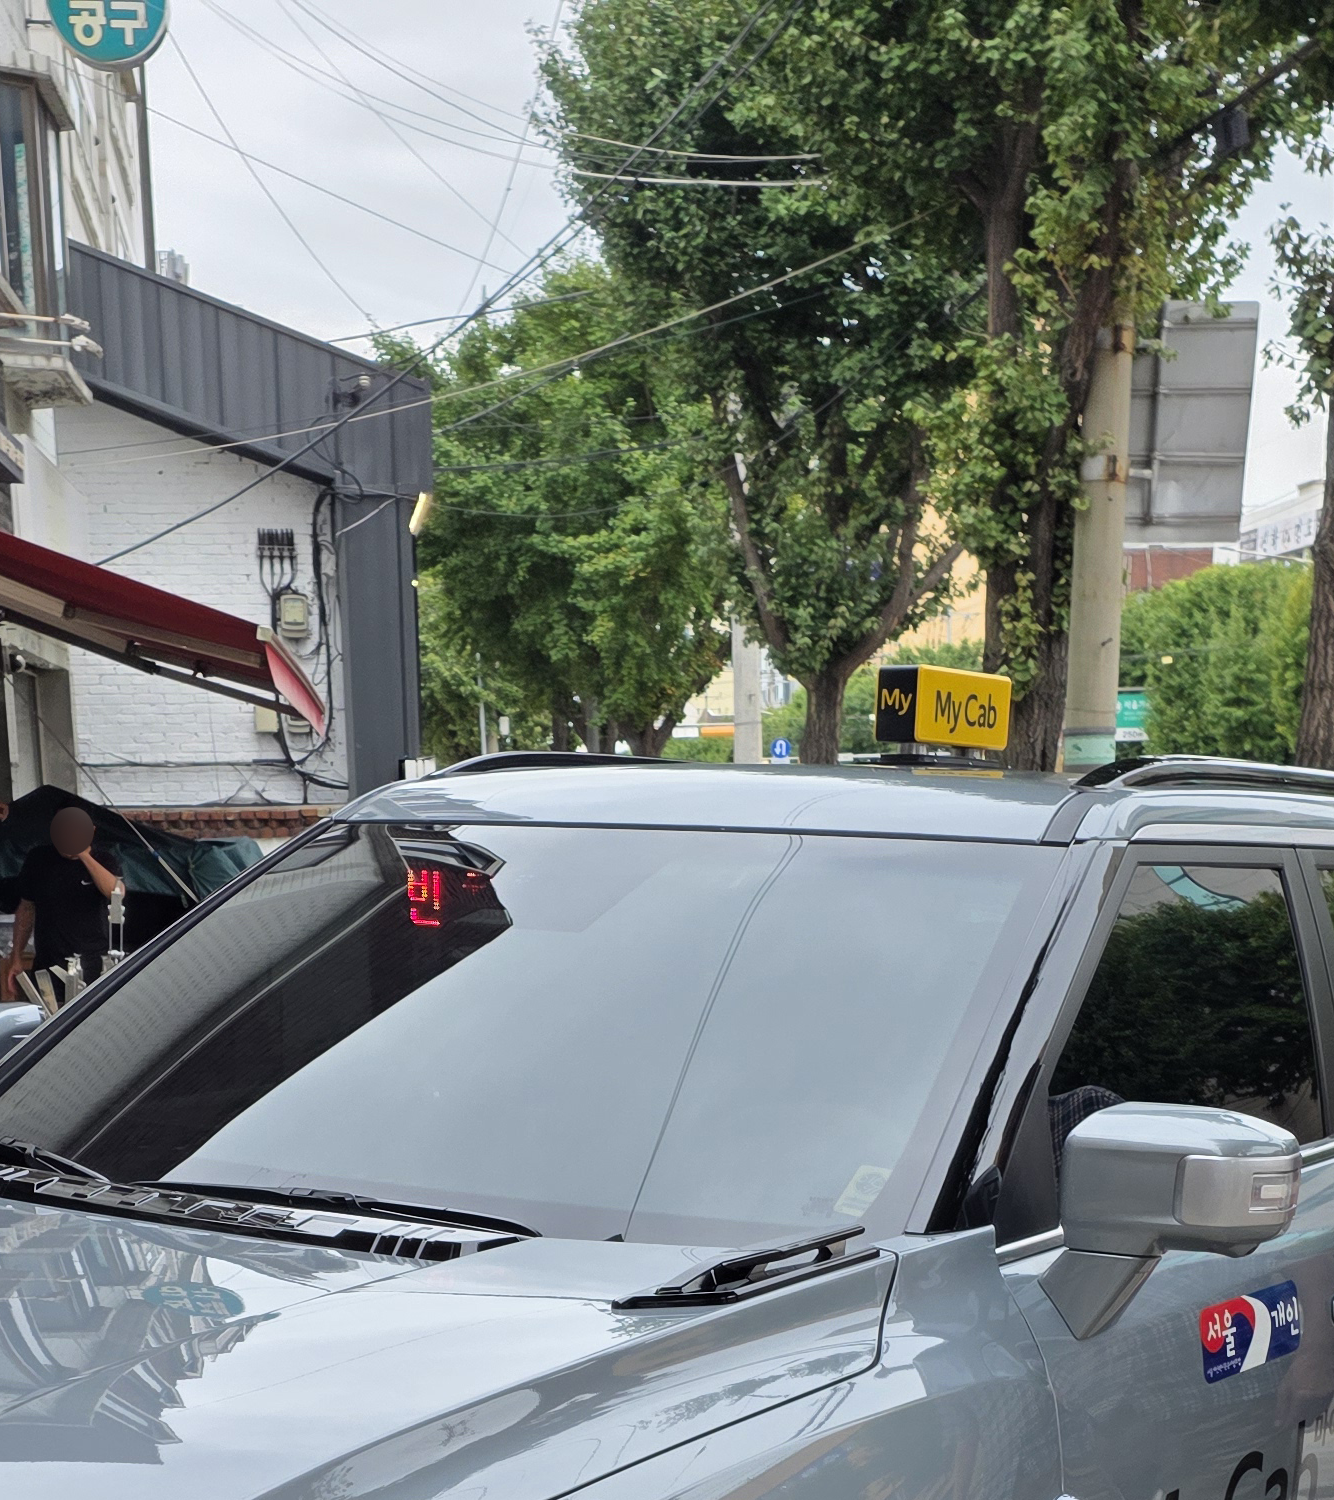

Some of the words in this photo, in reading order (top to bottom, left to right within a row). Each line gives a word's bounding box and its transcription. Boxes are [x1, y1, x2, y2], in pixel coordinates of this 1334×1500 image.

[68, 0, 148, 46] 공구
[880, 688, 913, 716] My
[934, 689, 962, 734] My
[964, 693, 997, 729] Cab
[1207, 1309, 1237, 1358] 서울
[1271, 1296, 1299, 1336] 개인
